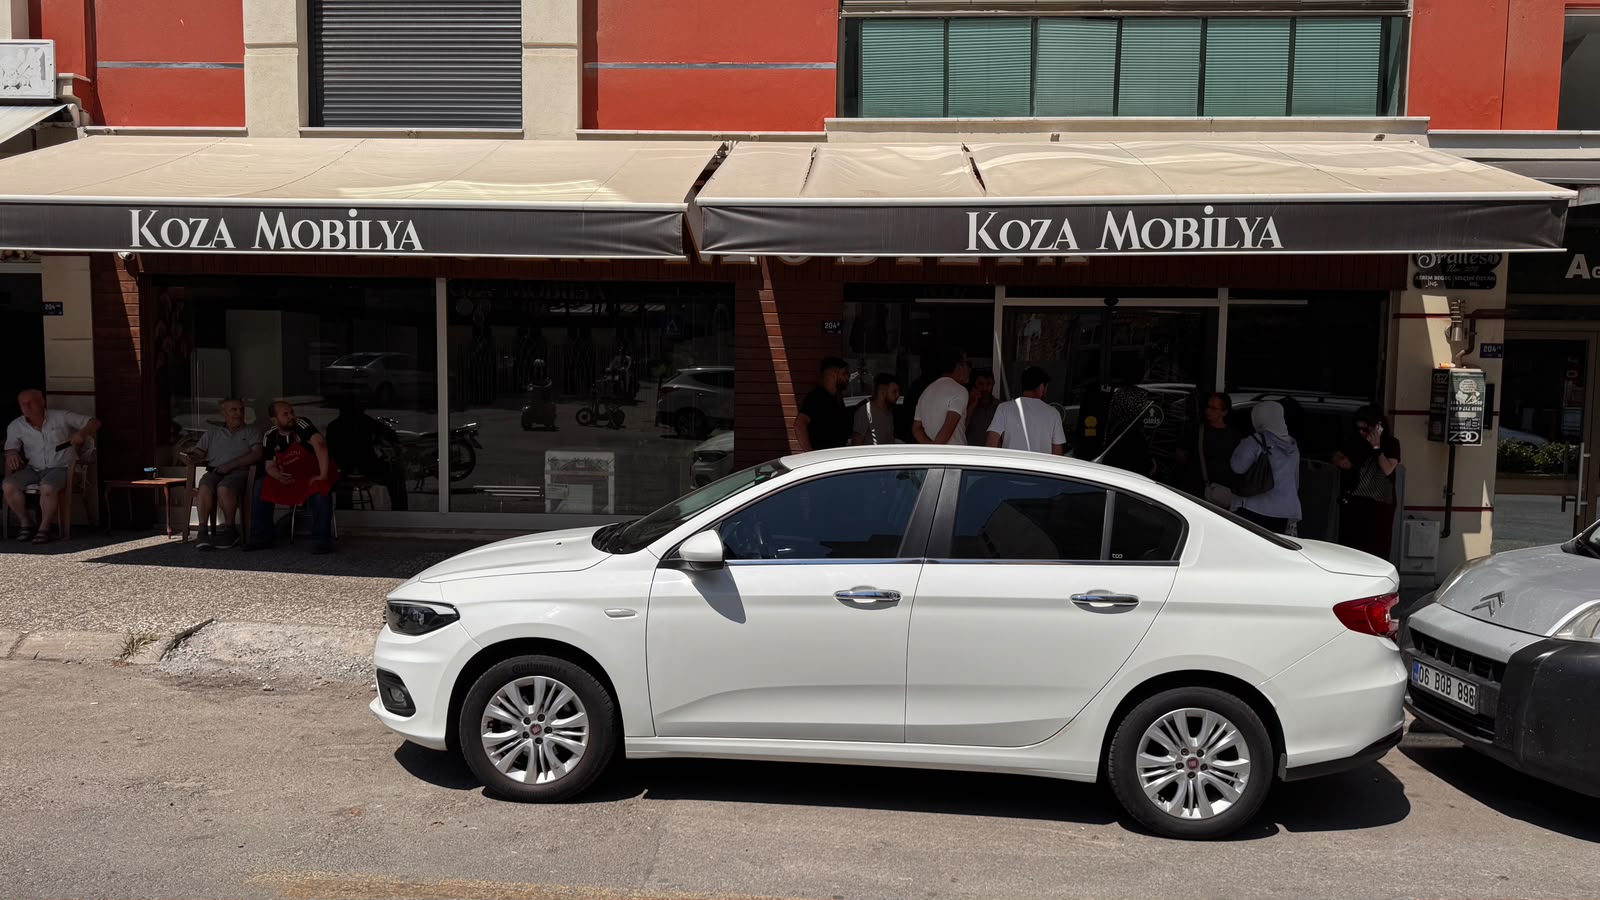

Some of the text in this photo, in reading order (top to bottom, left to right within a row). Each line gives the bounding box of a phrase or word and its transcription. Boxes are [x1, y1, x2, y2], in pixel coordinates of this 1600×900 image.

[129, 208, 424, 250] KOZA MOBİLYA
[965, 205, 1284, 251] KOZA MOBİLYA
[1419, 666, 1431, 686] 06
[1457, 682, 1475, 707] 898
